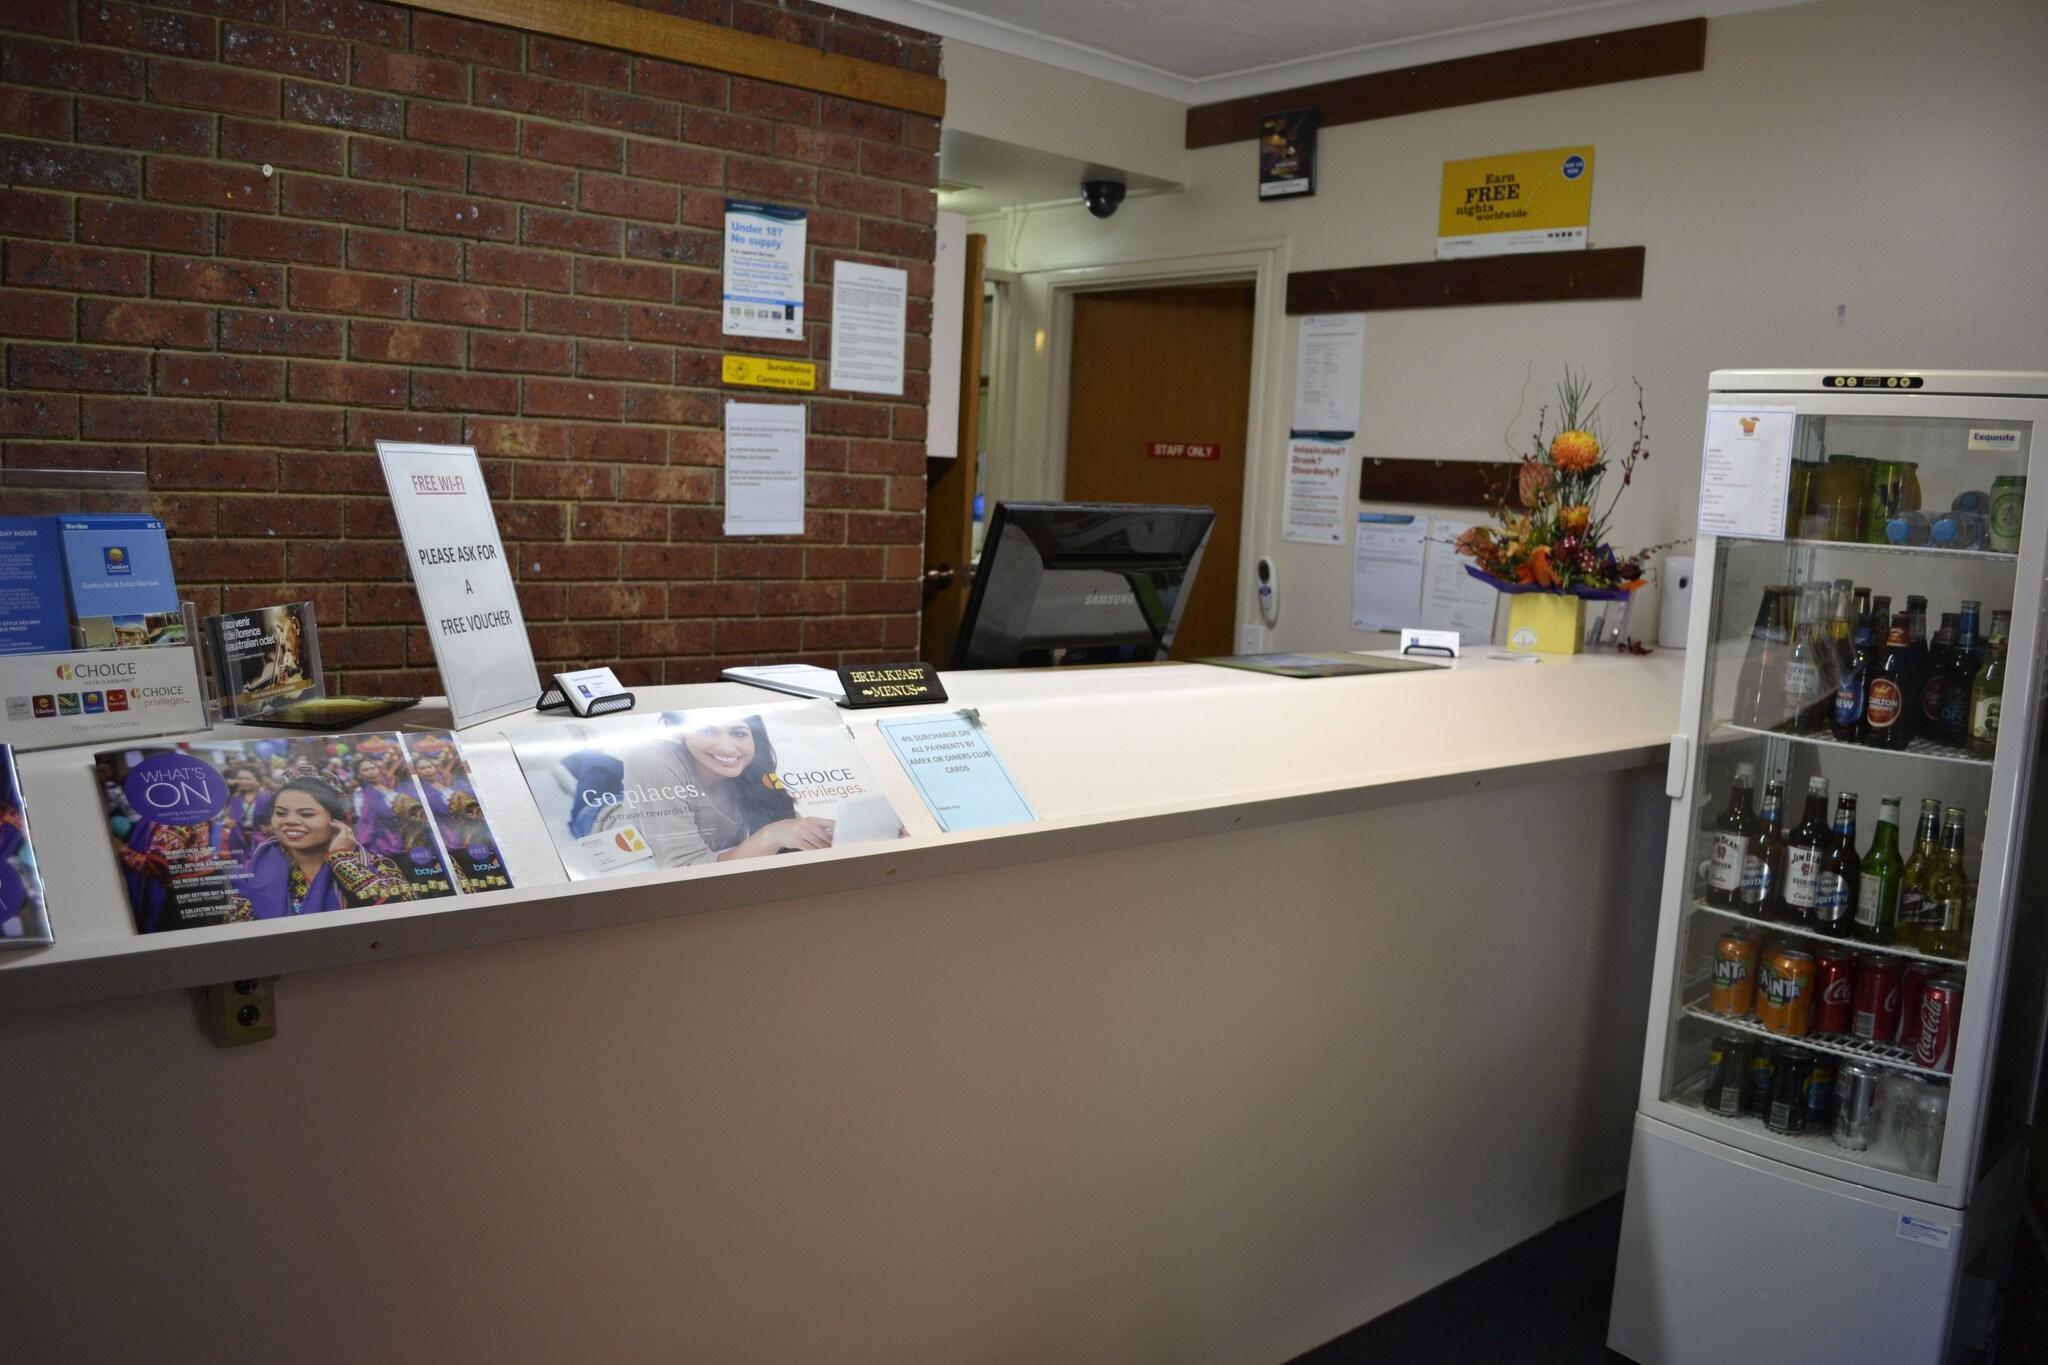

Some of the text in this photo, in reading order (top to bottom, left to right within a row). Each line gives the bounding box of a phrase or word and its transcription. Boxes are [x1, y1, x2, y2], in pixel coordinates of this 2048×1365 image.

[1485, 173, 1515, 184] Earn
[1465, 184, 1520, 204] FREE
[1456, 202, 1495, 217] nights
[1476, 208, 1528, 222] worldwide
[731, 221, 783, 238] Under 18?
[731, 233, 781, 250] No supply
[767, 362, 812, 374] Surveillance
[756, 375, 786, 386] Camera
[797, 377, 811, 387] Use
[1974, 432, 2015, 444] Exquisite
[1154, 444, 1213, 458] STAFF ONLY
[1292, 445, 1346, 456] Intoxicated?
[1292, 455, 1322, 466] Drunk?
[1291, 465, 1340, 477] Disorderly?
[411, 474, 465, 491] FREE WI-FI
[419, 545, 498, 565] PLEASE ASK FOR
[465, 579, 474, 595] A
[1085, 593, 1135, 605] SAMSUNG
[441, 610, 513, 636] FREE VOUCHER
[235, 627, 261, 639] florence
[260, 635, 275, 646] octet
[75, 663, 137, 678] CHOICE
[850, 668, 924, 683] BREAKFAST
[143, 686, 184, 698] CHOICE
[872, 684, 918, 697] MENUS
[144, 696, 185, 710] privileges
[914, 731, 958, 742] SURCHARGE
[925, 743, 962, 752] PAYMENTS
[909, 751, 991, 766] AMEX OR DINERS CLUB
[140, 767, 206, 783] WHAT'S
[945, 765, 970, 773] CARDS
[783, 768, 855, 786] CHOICE
[146, 780, 211, 808] ON
[582, 784, 706, 809] Go places.
[617, 811, 644, 821] travel
[645, 806, 683, 818] rewards
